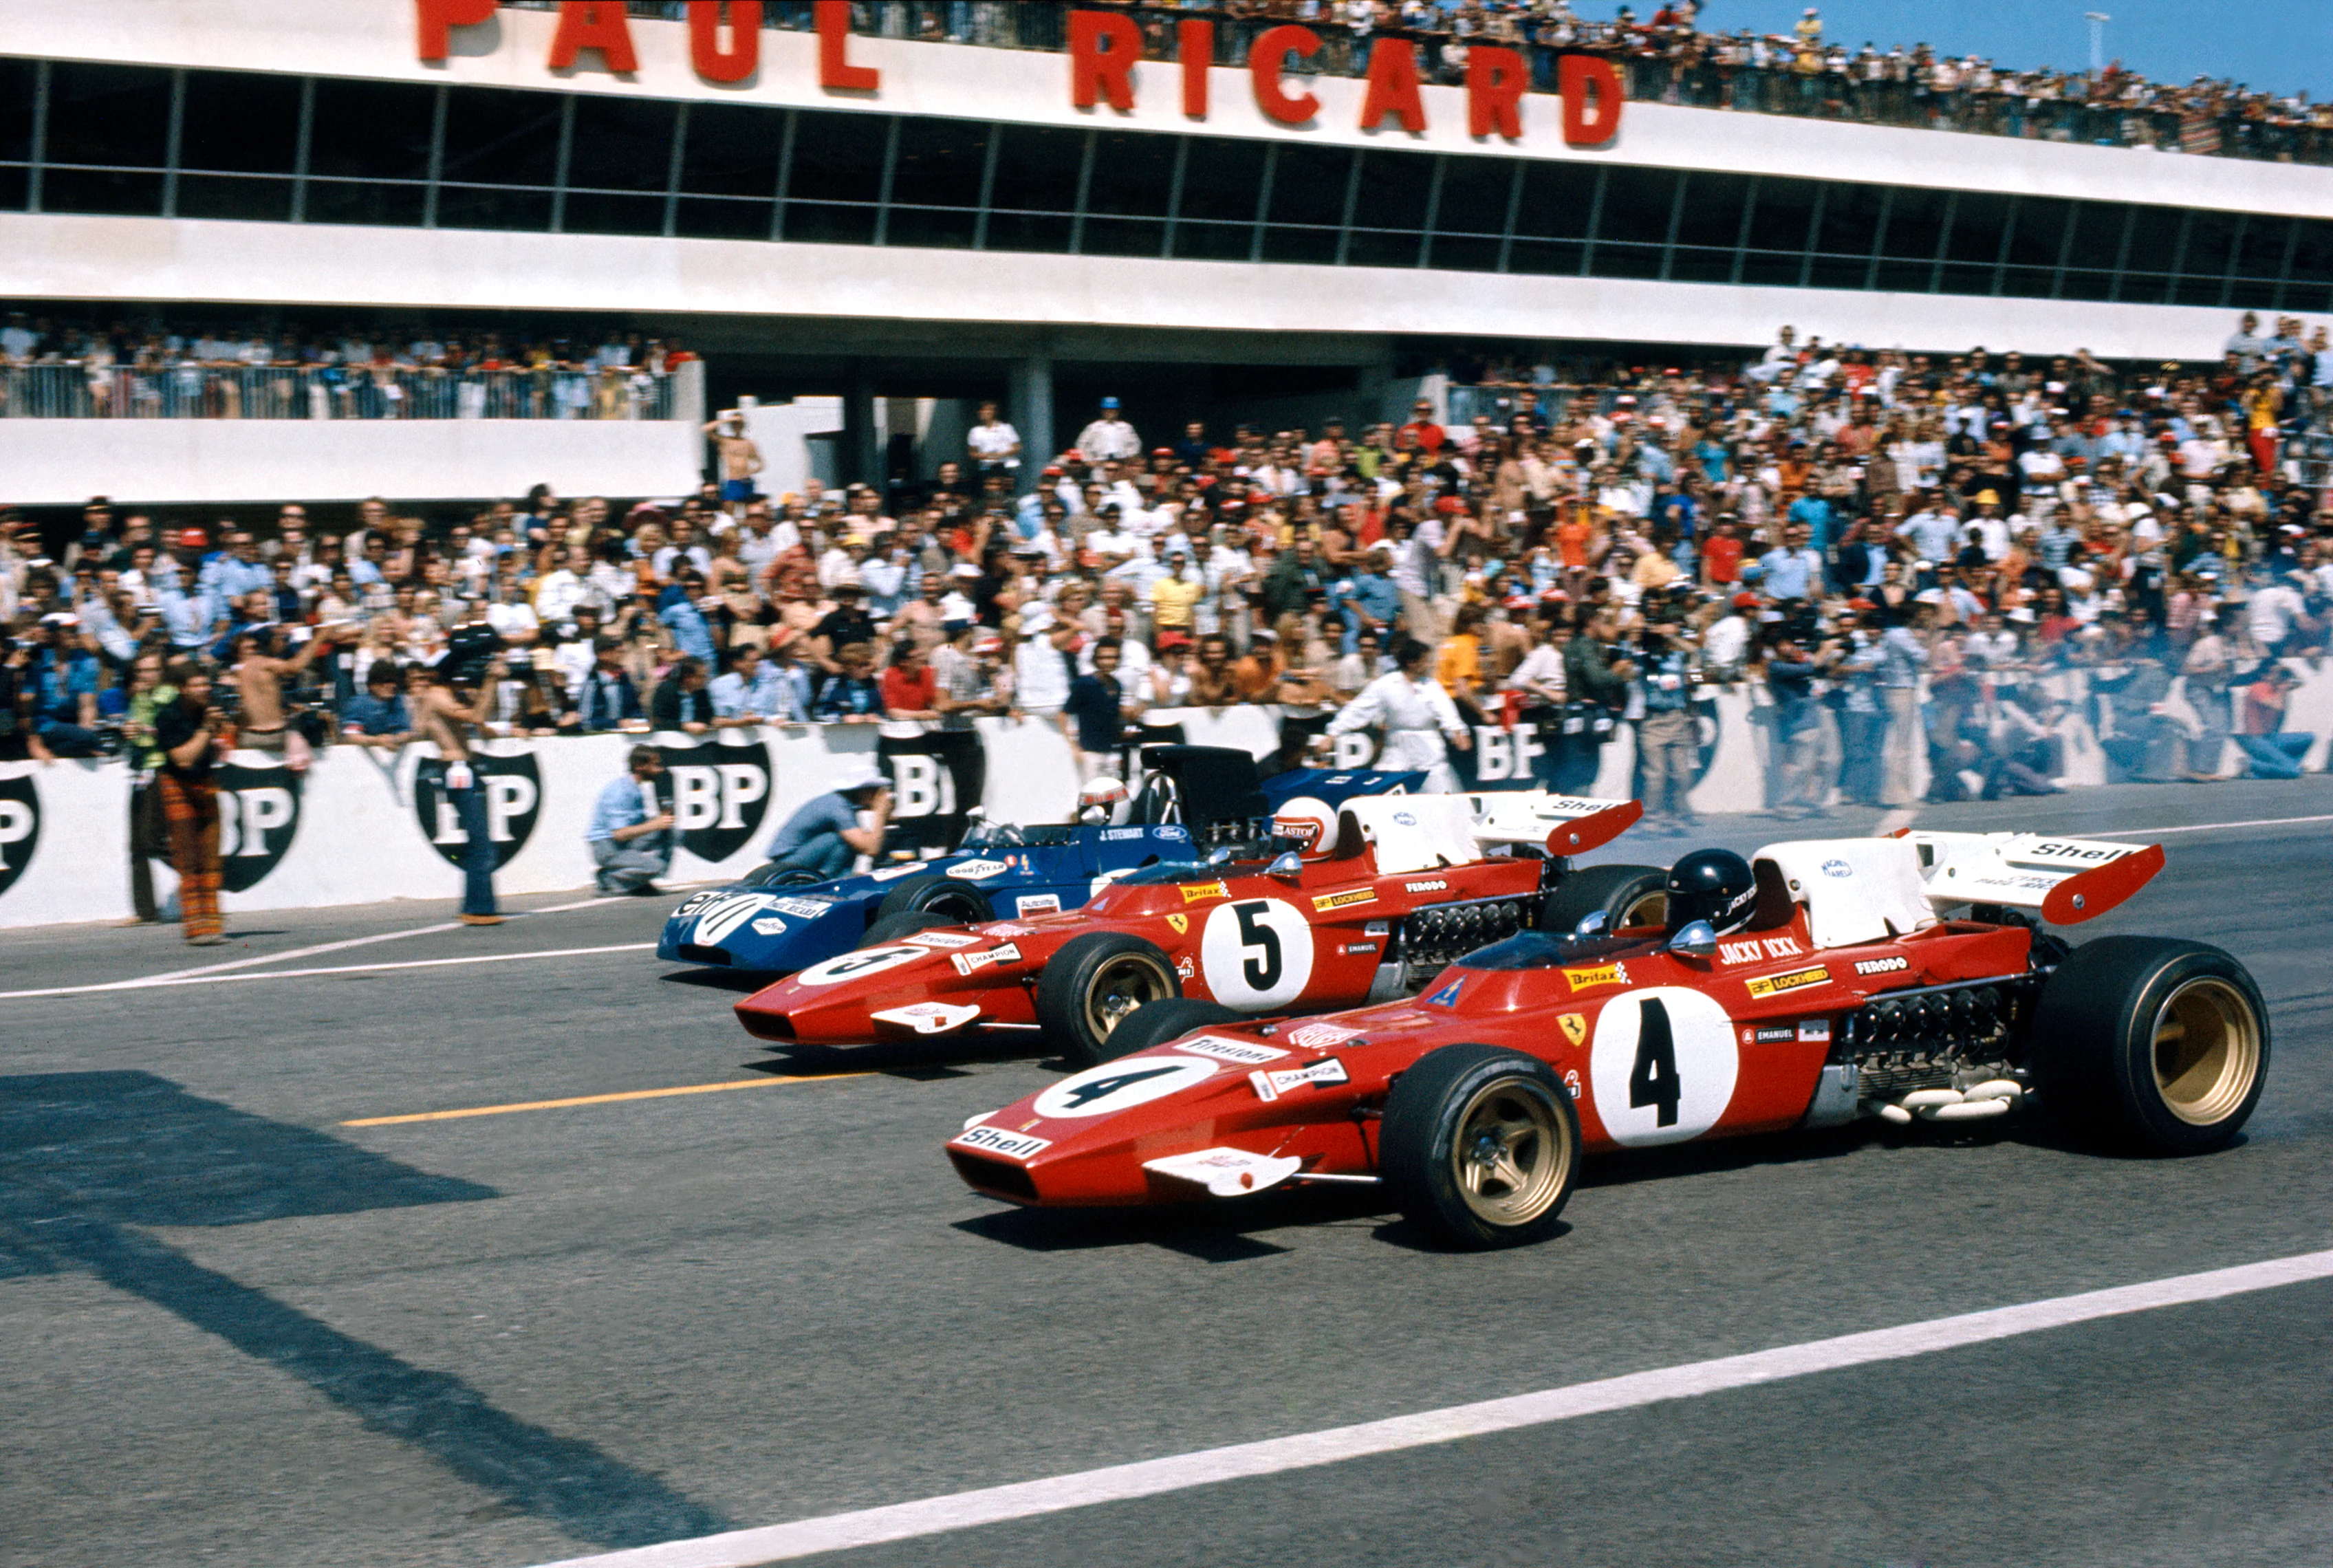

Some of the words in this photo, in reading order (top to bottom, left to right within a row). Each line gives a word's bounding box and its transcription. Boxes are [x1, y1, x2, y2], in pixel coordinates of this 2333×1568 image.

[415, 0, 881, 90] PAUL
[1067, 9, 1623, 144] RICARD
[670, 763, 768, 829] BP
[1552, 800, 1621, 812] Shel
[0, 799, 35, 870] P
[1185, 889, 1220, 898] Britax
[1405, 880, 1448, 893] FERODO
[1332, 891, 1375, 906] LOCKHEED
[1725, 891, 1748, 917] JACKY
[970, 948, 1016, 963] CHAMPION
[1230, 900, 1283, 991] 5
[1348, 944, 1376, 953] EMANUEL
[1719, 940, 1763, 965] JACKY
[1762, 937, 1803, 958] ICKX
[1855, 957, 1908, 974] FERODO
[1572, 972, 1616, 985] Britax
[1773, 969, 1828, 989] LOCKHEED
[1757, 1029, 1794, 1040] EMANUEL
[1186, 1038, 1275, 1061] Firestone
[1629, 997, 1681, 1128] 4
[1276, 1067, 1339, 1085] CHAMPION
[1060, 1065, 1189, 1109] 4
[962, 1129, 1043, 1155] Shell
